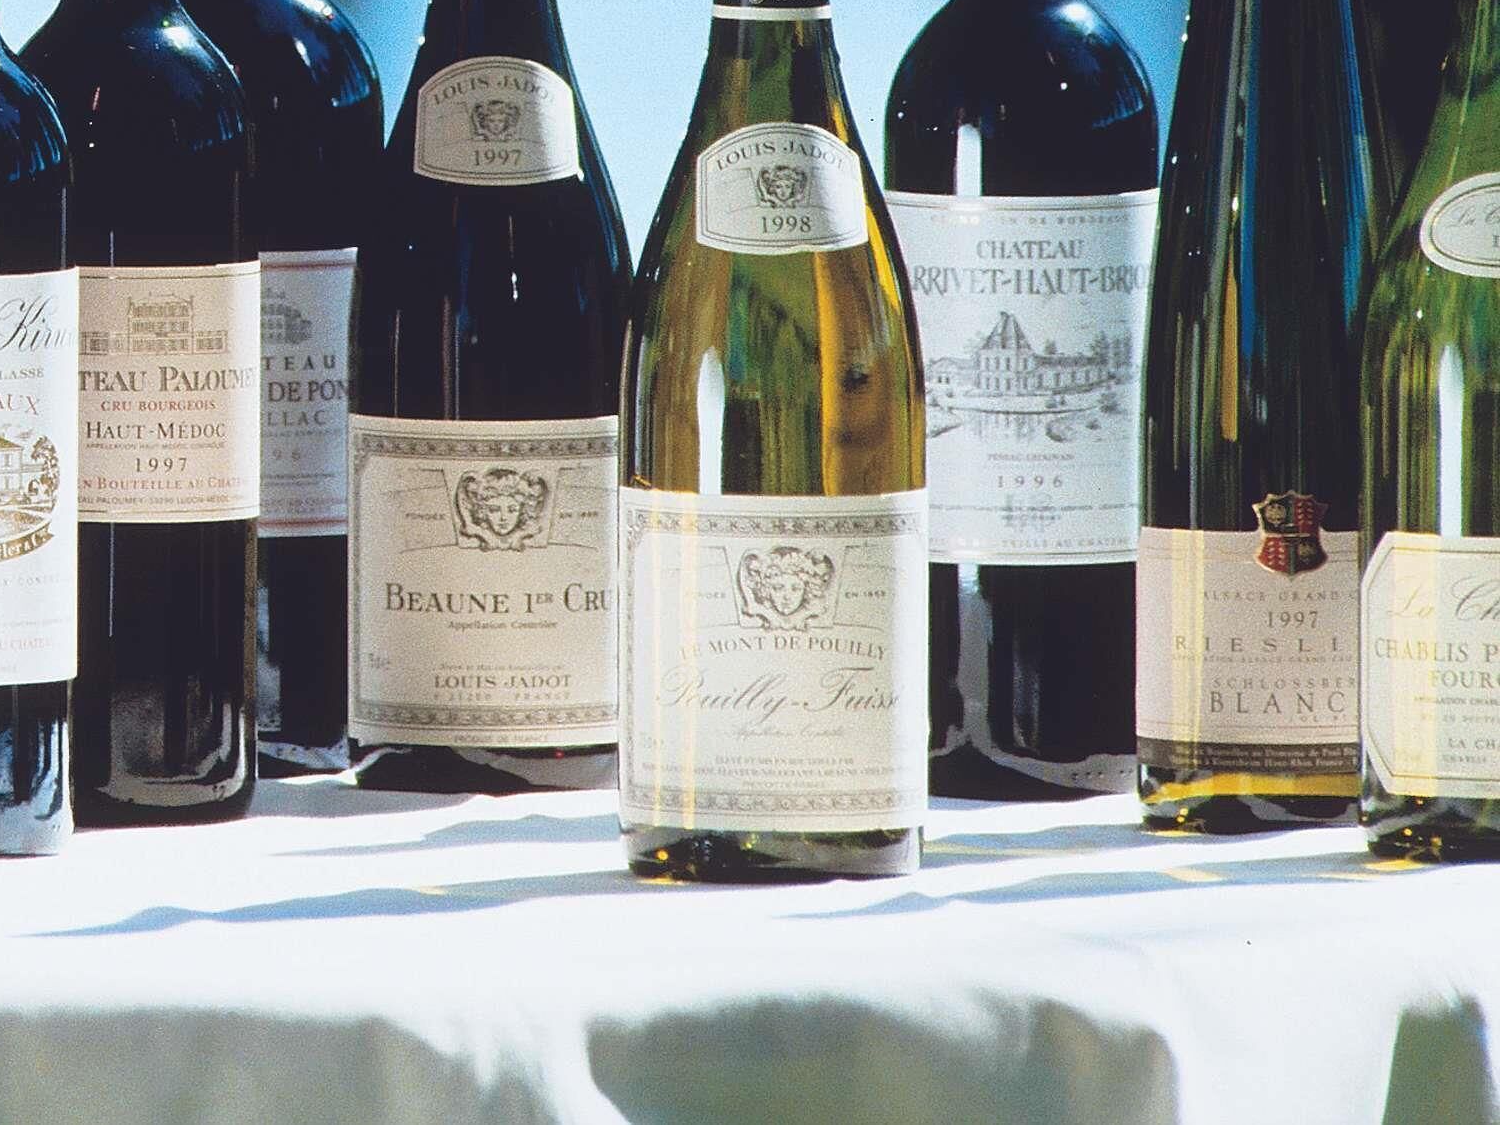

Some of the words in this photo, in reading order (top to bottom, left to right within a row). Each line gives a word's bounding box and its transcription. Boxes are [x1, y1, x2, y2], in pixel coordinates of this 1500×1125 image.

[433, 76, 489, 106] LOUIS
[473, 149, 522, 166] 1997
[716, 141, 776, 171] LOUIS
[761, 216, 813, 233] 1998
[976, 238, 1086, 260] CHATEAU
[100, 401, 133, 413] CRU
[138, 400, 217, 413] BOURGEOIS
[135, 457, 189, 473] 1997
[96, 476, 183, 491] BOUTEILLE
[998, 475, 1065, 489] 1996
[385, 582, 510, 615] BEAUNE
[1266, 610, 1319, 630] 1997
[708, 635, 767, 654] MONT
[774, 635, 801, 650] DE
[807, 635, 888, 662] POUILLY
[1374, 637, 1469, 663] CHABLIS
[434, 674, 497, 690] LOUIS
[503, 674, 572, 690] JADOT
[1209, 691, 1346, 715] BLANC
